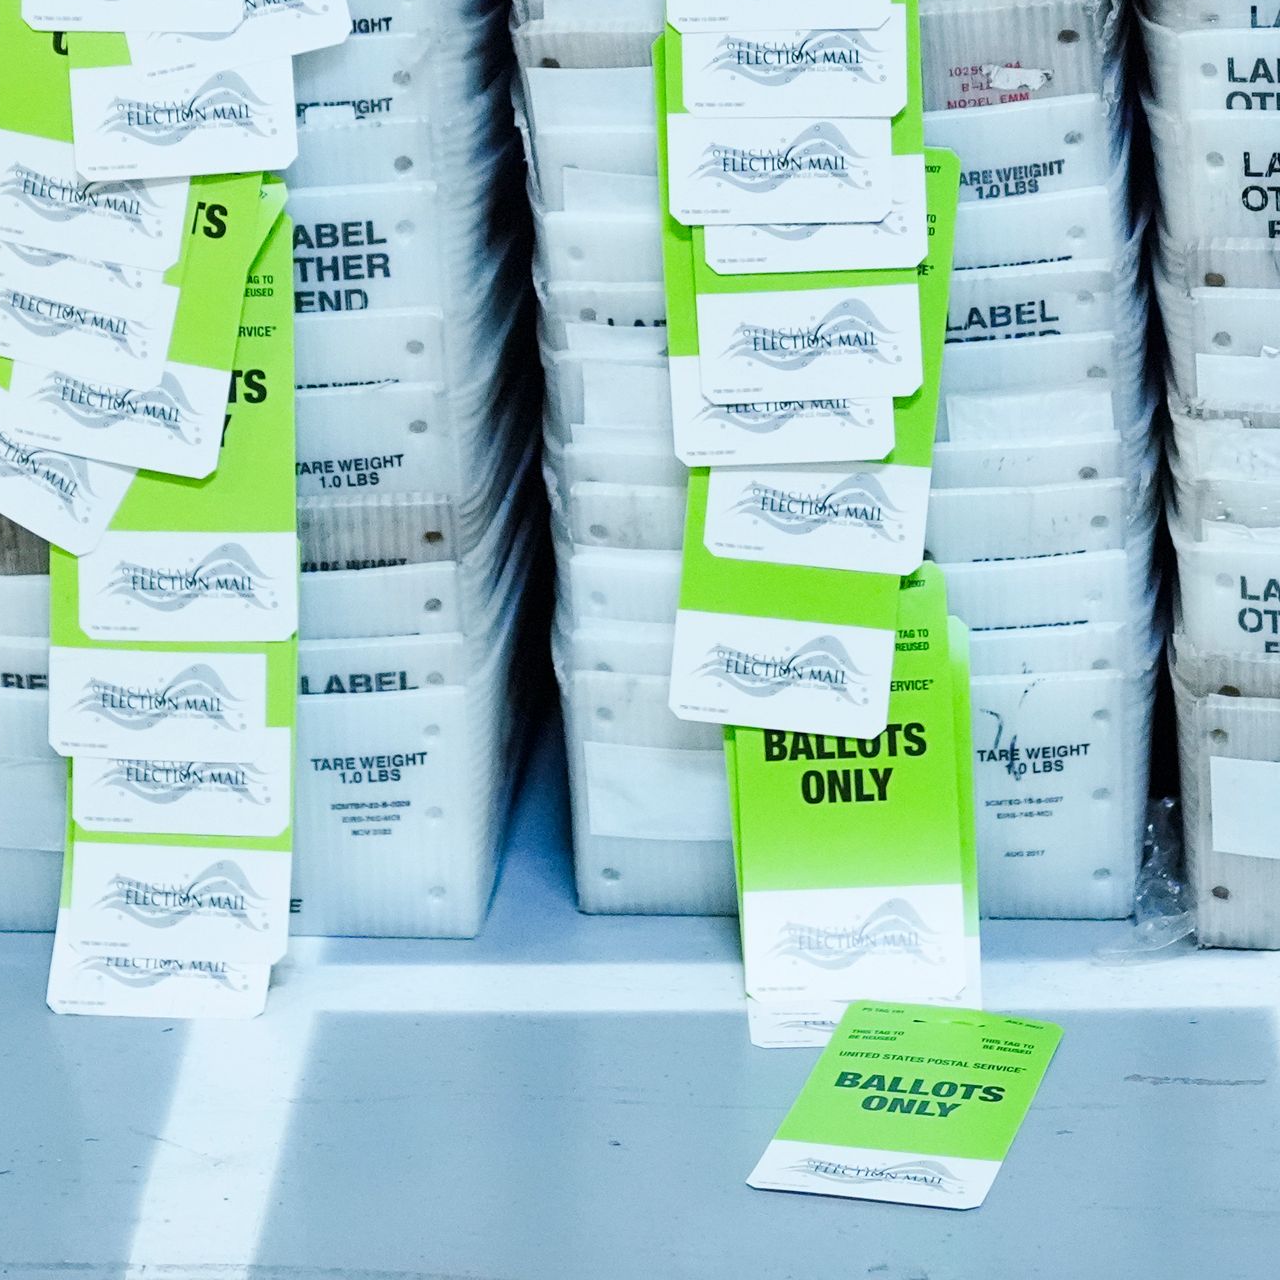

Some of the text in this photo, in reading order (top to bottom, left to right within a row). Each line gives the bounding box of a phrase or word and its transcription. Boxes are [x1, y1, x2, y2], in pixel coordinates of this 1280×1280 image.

[311, 752, 427, 771] TARE WEIGHT
[340, 769, 401, 783] 1.0 LBS
[839, 1050, 879, 1059] UNITED
[883, 1052, 924, 1063] STATES
[927, 1058, 968, 1067] POSTAL
[835, 1072, 1005, 1107] BALLOTS
[862, 1096, 961, 1117] ONLY
